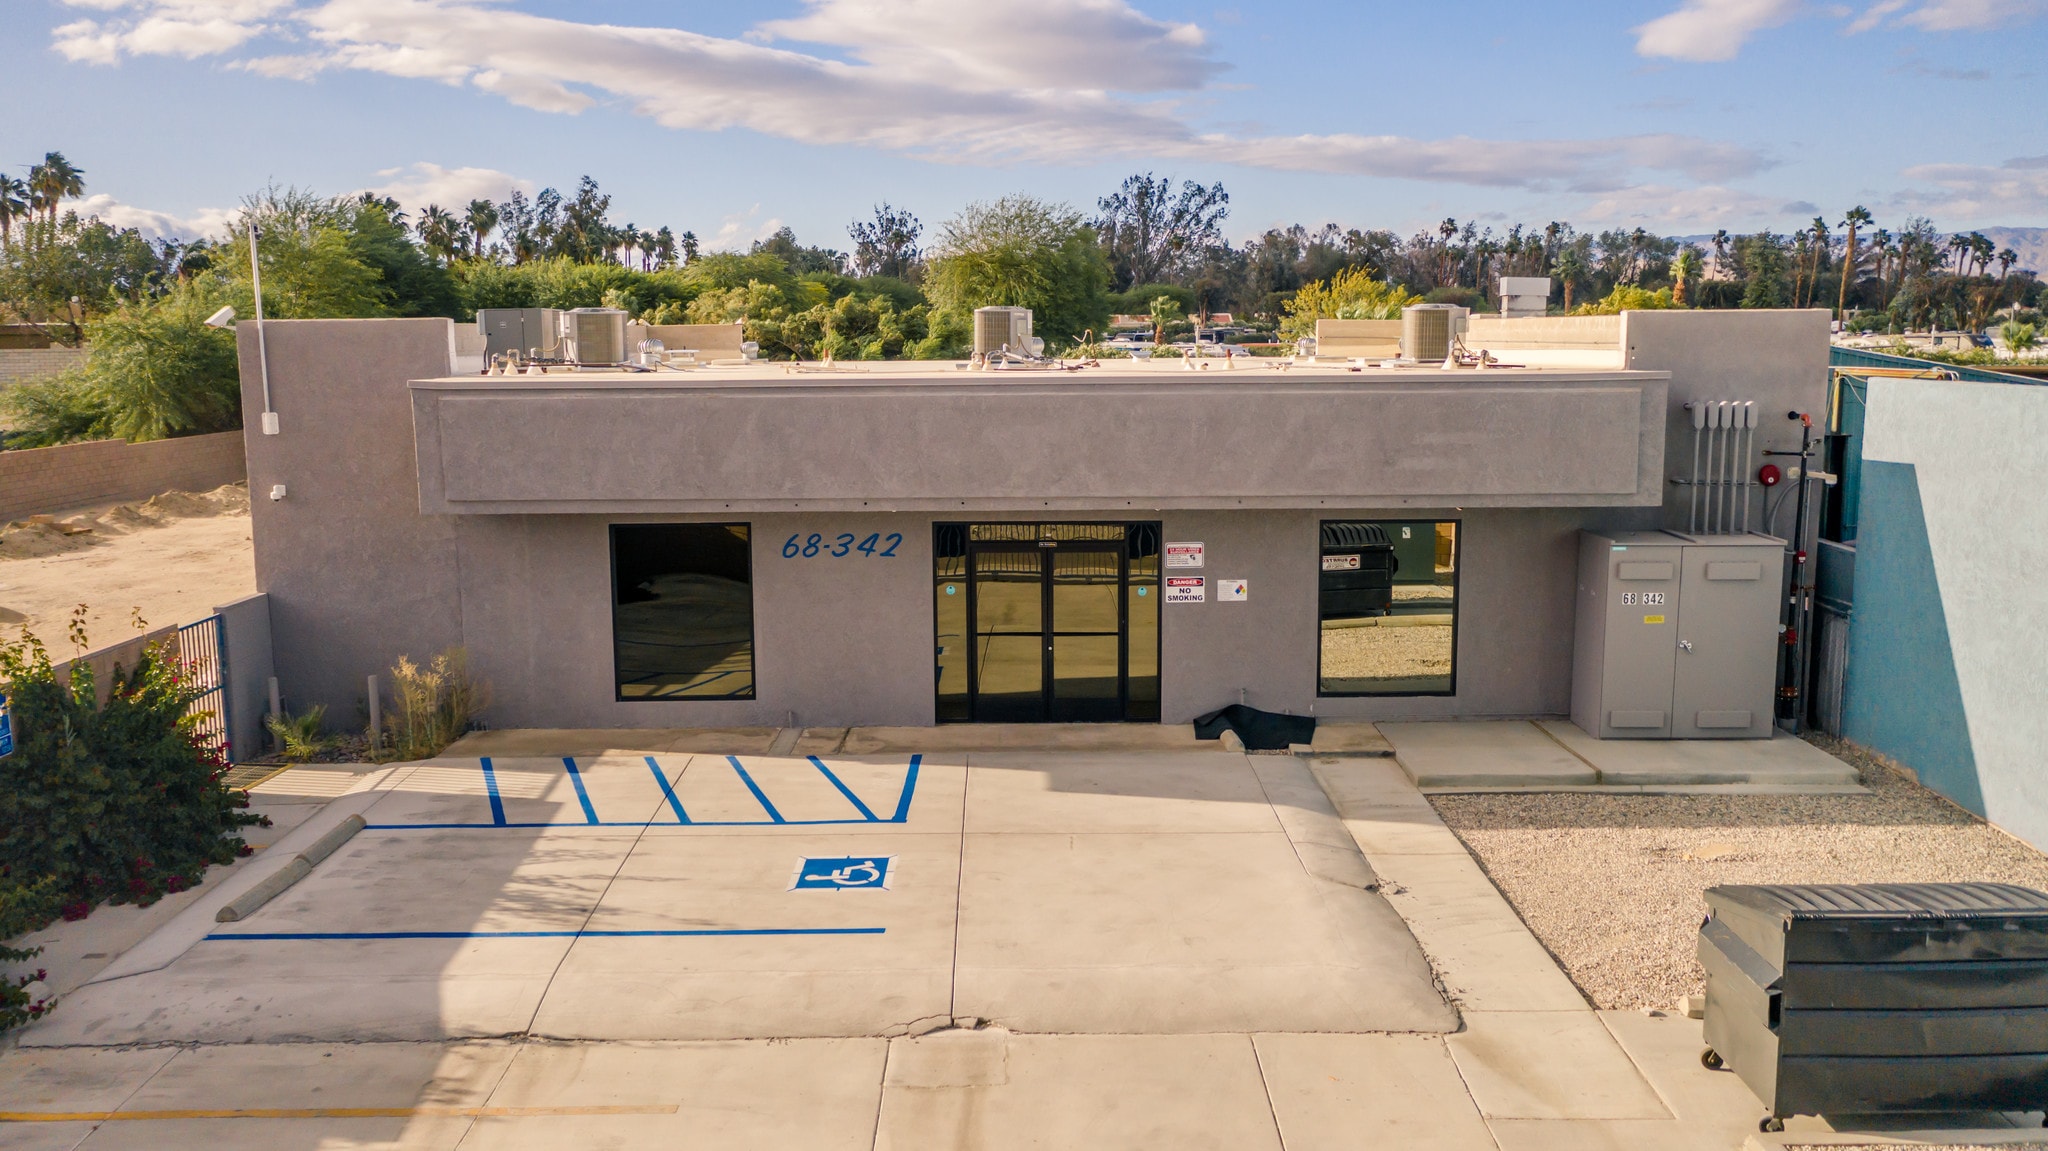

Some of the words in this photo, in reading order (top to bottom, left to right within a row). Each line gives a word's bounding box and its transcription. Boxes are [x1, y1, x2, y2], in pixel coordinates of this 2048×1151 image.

[782, 532, 903, 558] 68-342
[1623, 593, 1636, 604] 68
[1643, 593, 1664, 604] 342
